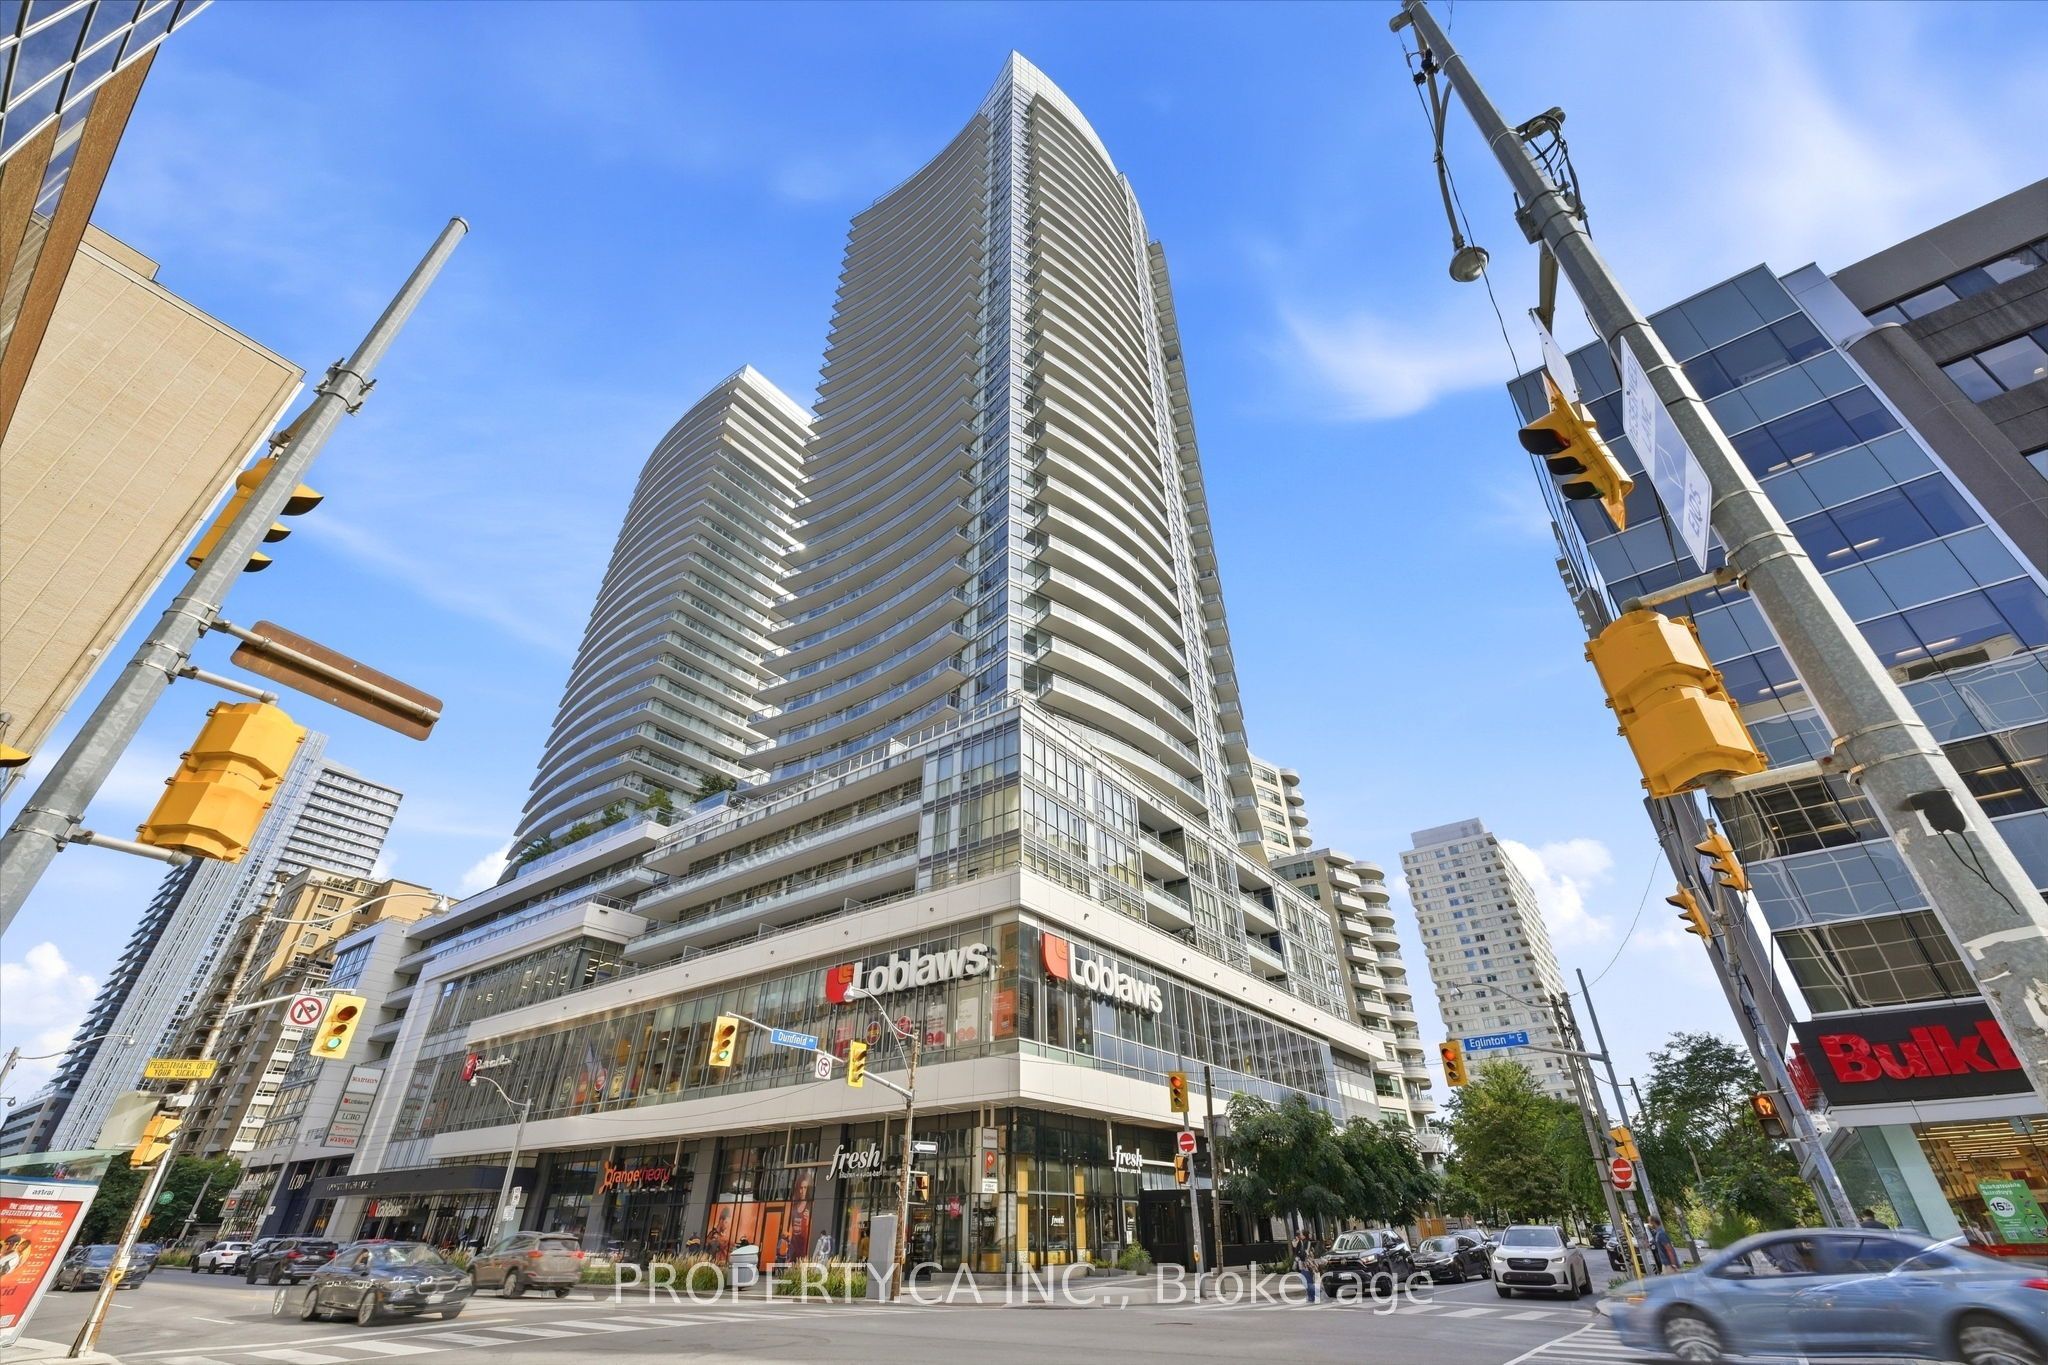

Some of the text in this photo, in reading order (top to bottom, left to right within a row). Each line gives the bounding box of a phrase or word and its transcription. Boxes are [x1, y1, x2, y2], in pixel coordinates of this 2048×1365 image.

[1688, 483, 1703, 538] ENDS
[852, 943, 989, 999] Loblaws
[1069, 943, 1163, 1014] Loblaws
[778, 1032, 807, 1045] Dunfield
[1470, 1037, 1506, 1049] Eglinton
[1516, 1033, 1524, 1042] E
[154, 1069, 172, 1077] YOUR
[342, 1112, 361, 1120] LCBO
[826, 1142, 880, 1181] fresh
[1115, 1145, 1143, 1168] fresh
